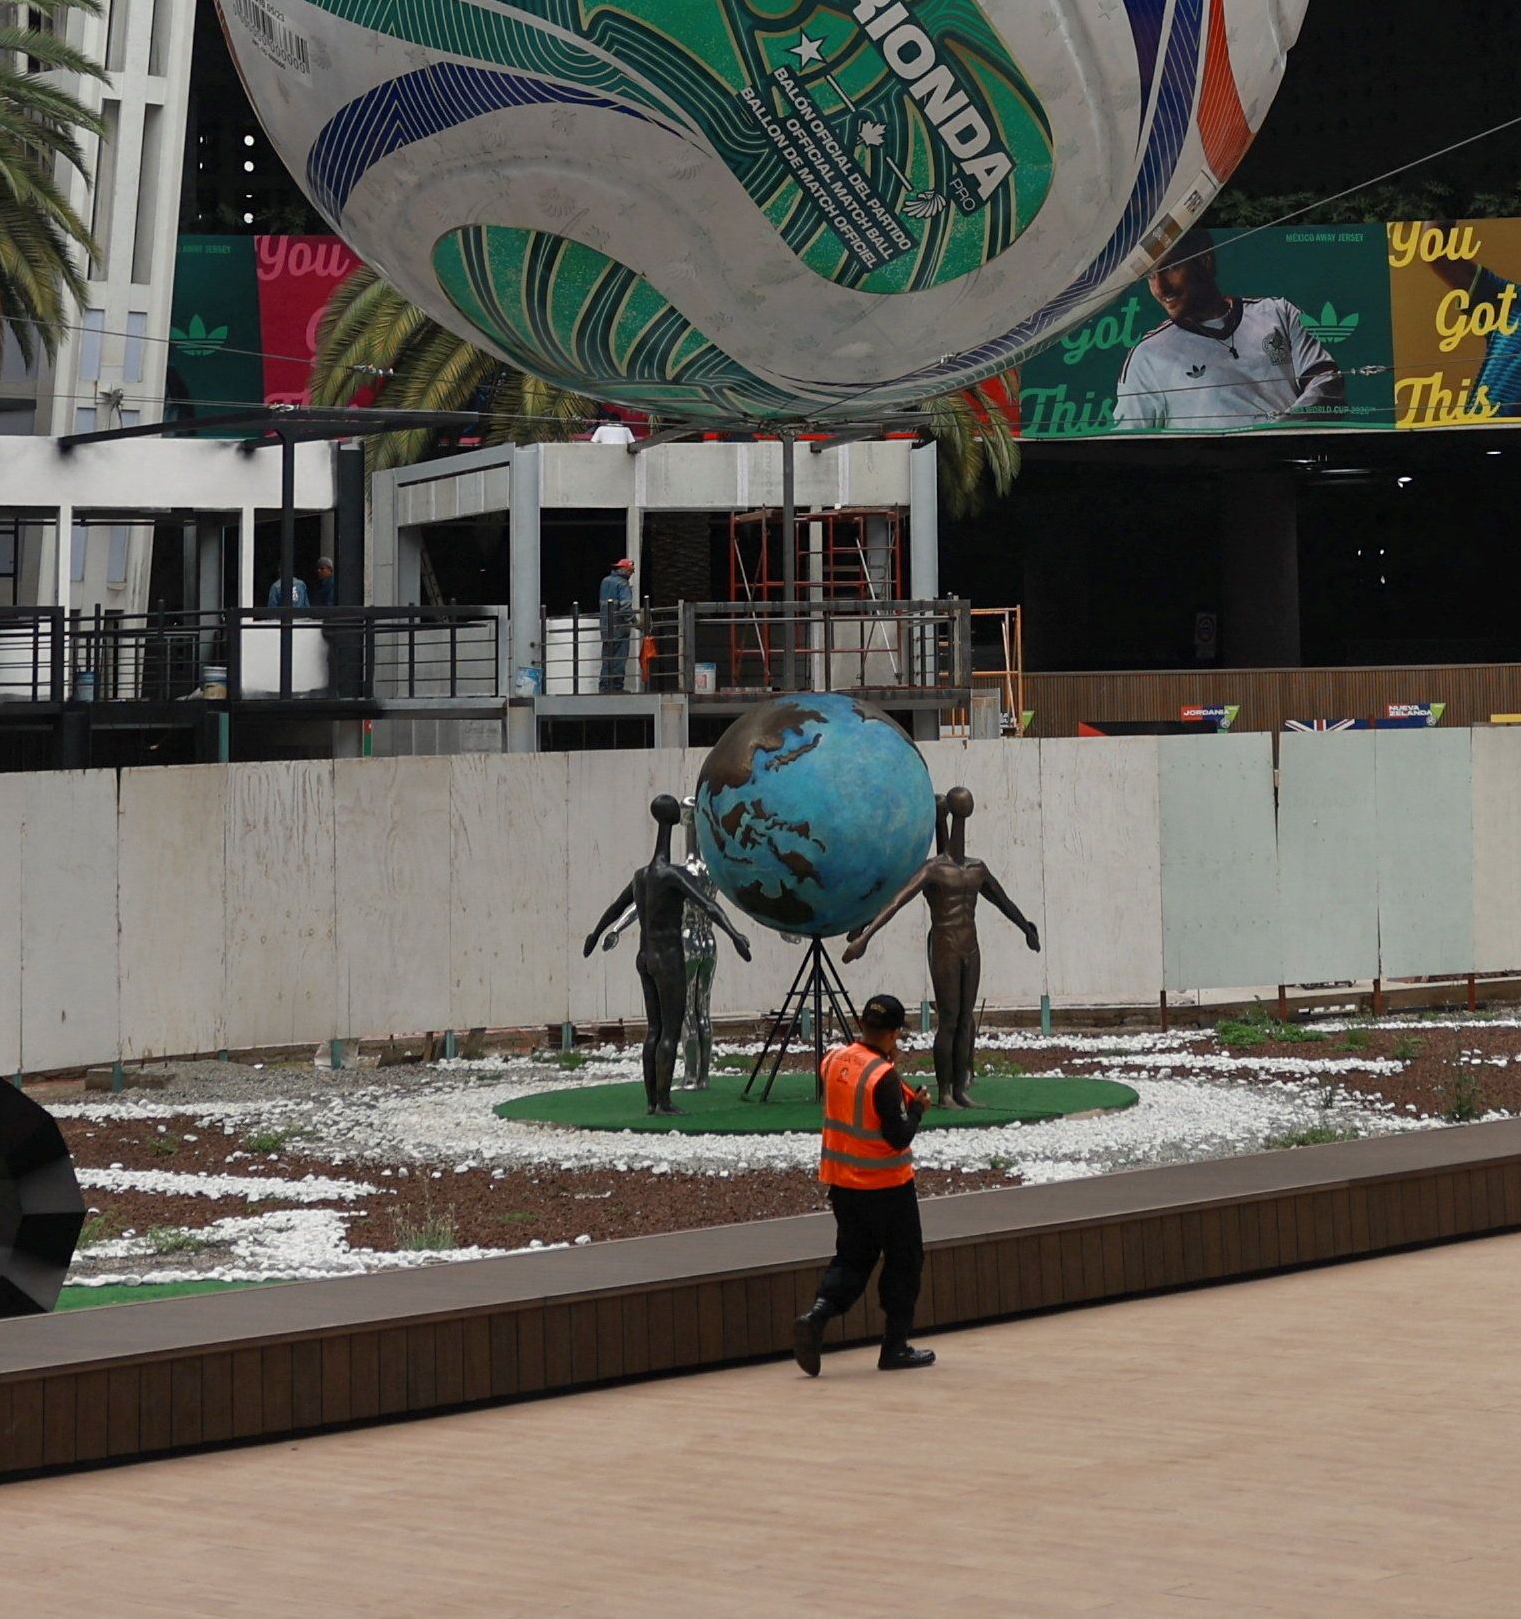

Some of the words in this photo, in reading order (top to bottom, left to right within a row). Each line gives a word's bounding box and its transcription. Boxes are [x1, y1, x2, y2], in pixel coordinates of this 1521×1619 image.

[740, 87, 789, 148] BALLON
[782, 147, 804, 169] DE
[797, 167, 840, 217] MATCH
[833, 216, 877, 269] OFFICIEL
[774, 67, 817, 121] BALÓN
[810, 119, 852, 175] OFICIAL
[848, 173, 871, 201] DEL
[867, 198, 911, 250] PARTIDO
[786, 119, 835, 183] OFFICIAL
[831, 181, 873, 229] MATCH
[866, 227, 893, 260] BALL
[949, 178, 977, 211] PRO
[255, 235, 350, 281] You
[1285, 232, 1315, 243] MÉXICO
[1316, 233, 1335, 242] AWAY
[1337, 233, 1364, 243] JERSEY
[1387, 221, 1481, 268] You
[1435, 283, 1519, 352] Got
[1021, 383, 1129, 437] This
[1395, 371, 1501, 427] This
